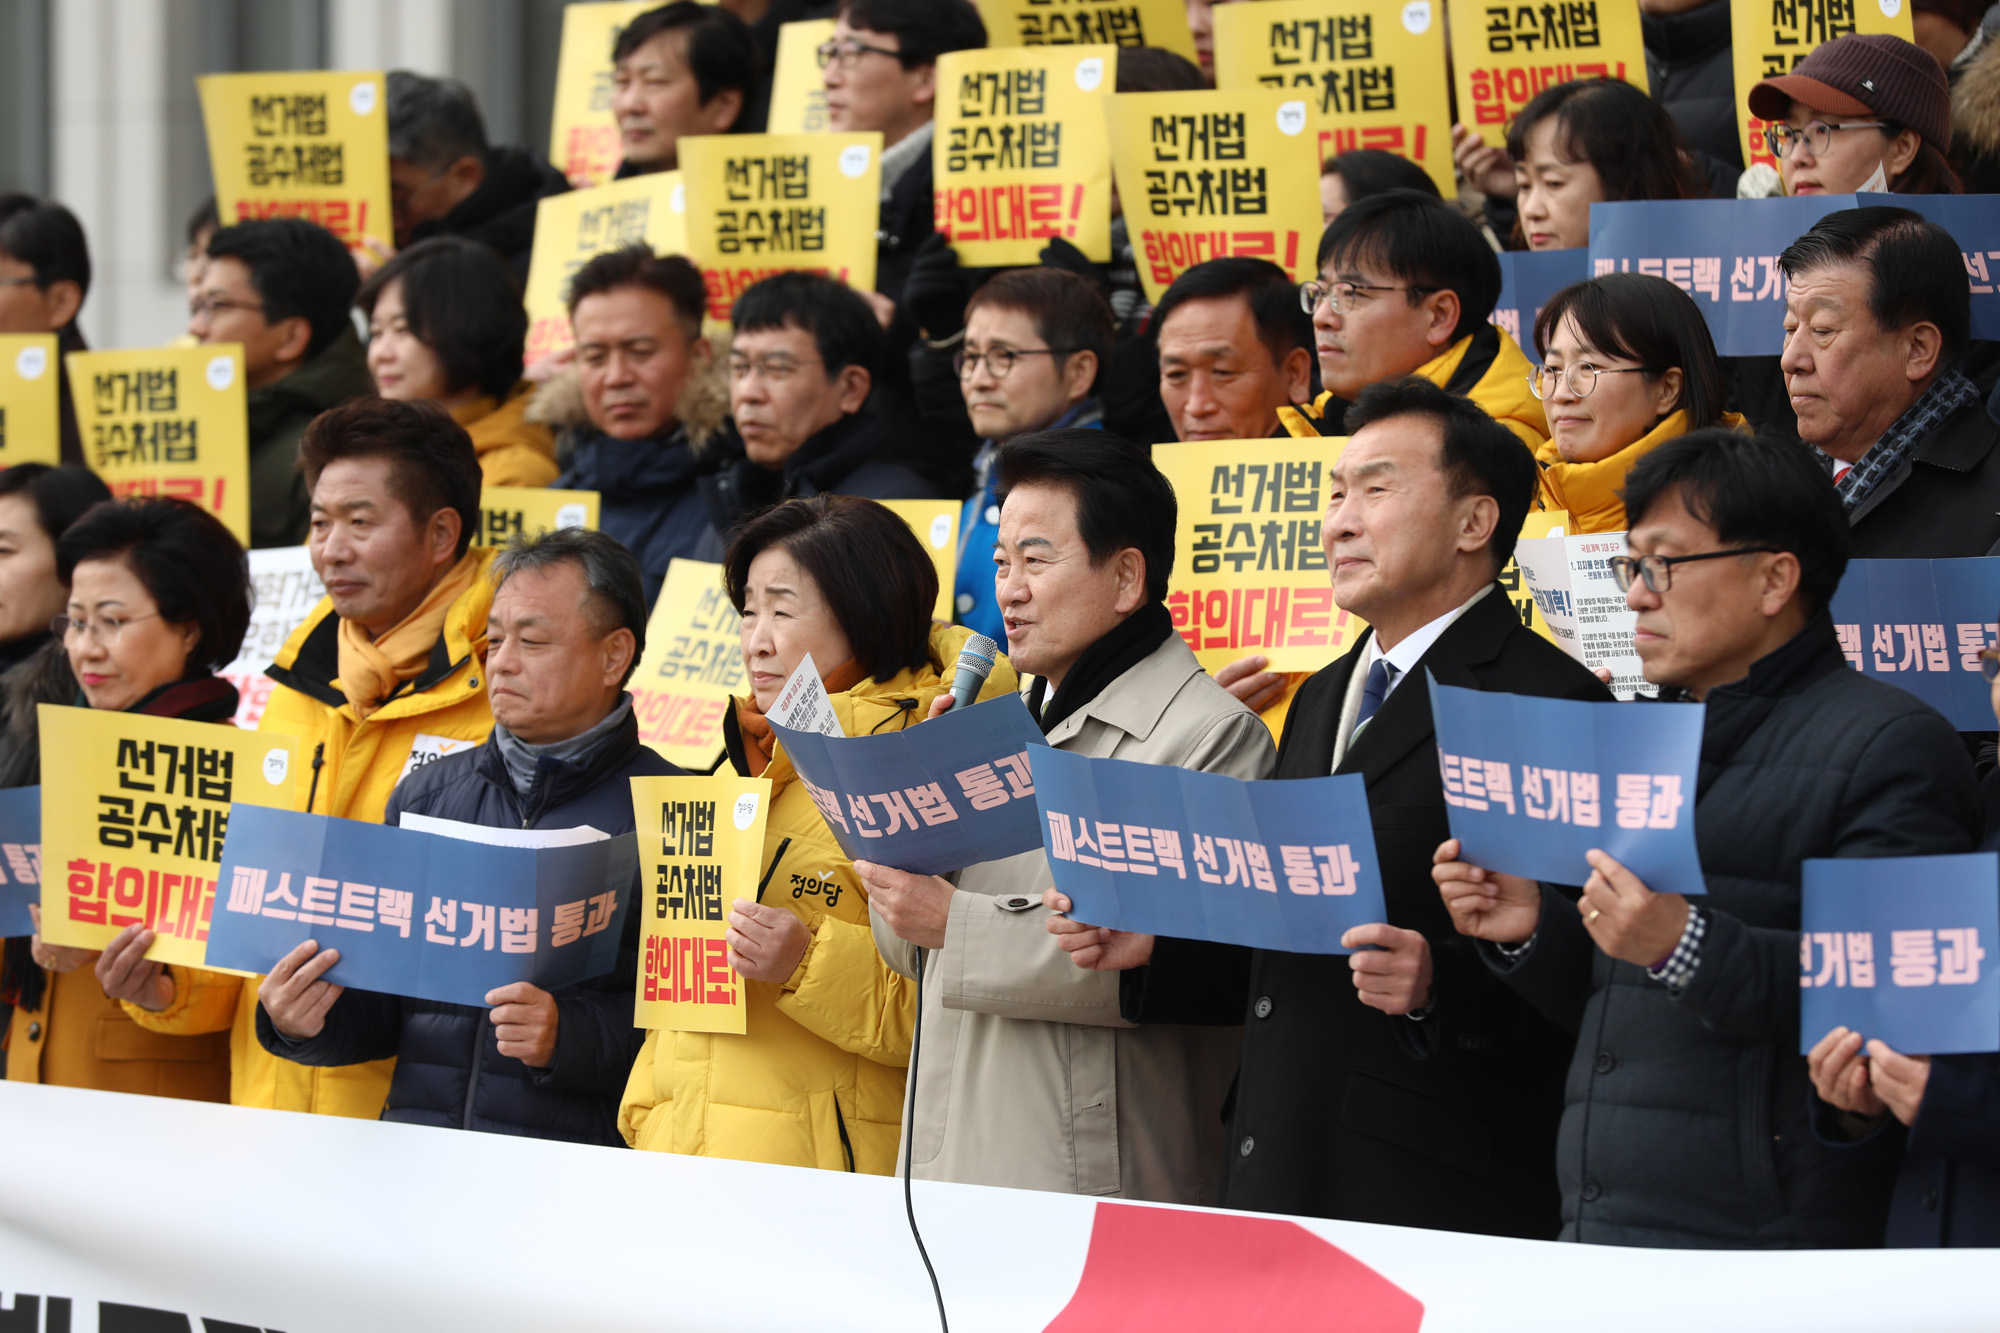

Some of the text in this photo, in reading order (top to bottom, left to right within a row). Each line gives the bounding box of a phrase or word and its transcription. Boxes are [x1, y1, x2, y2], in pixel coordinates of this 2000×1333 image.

[1271, 15, 1372, 65] 선거법
[1486, 2, 1601, 52] 공수처법
[251, 94, 327, 136] 선거법
[961, 69, 1045, 118] 선거법
[1259, 66, 1395, 114] 처법
[948, 123, 1060, 171] 공수처법
[1153, 113, 1246, 162] 선거법
[725, 155, 808, 201] 선거법
[1145, 168, 1267, 216] 공수처법
[716, 207, 825, 253] 공수처법
[93, 368, 178, 416] 선거법
[1210, 461, 1322, 515] 선거법
[1192, 520, 1329, 573] 공수처법
[1168, 587, 1350, 651] 합의대로!
[1872, 624, 1950, 672] 선거법
[117, 739, 234, 803] 선거법
[846, 782, 959, 838] 선거법
[1521, 765, 1601, 827] 선거법
[1615, 773, 1684, 829] 통과
[661, 801, 716, 856] 선거법
[1047, 810, 1360, 896] 패스트트랙 선거법 통과
[226, 865, 618, 954] 패스트트랙 선거법 통과
[656, 864, 723, 921] 공수처법
[790, 874, 844, 907] 정의당
[1890, 927, 1986, 988] 통과
